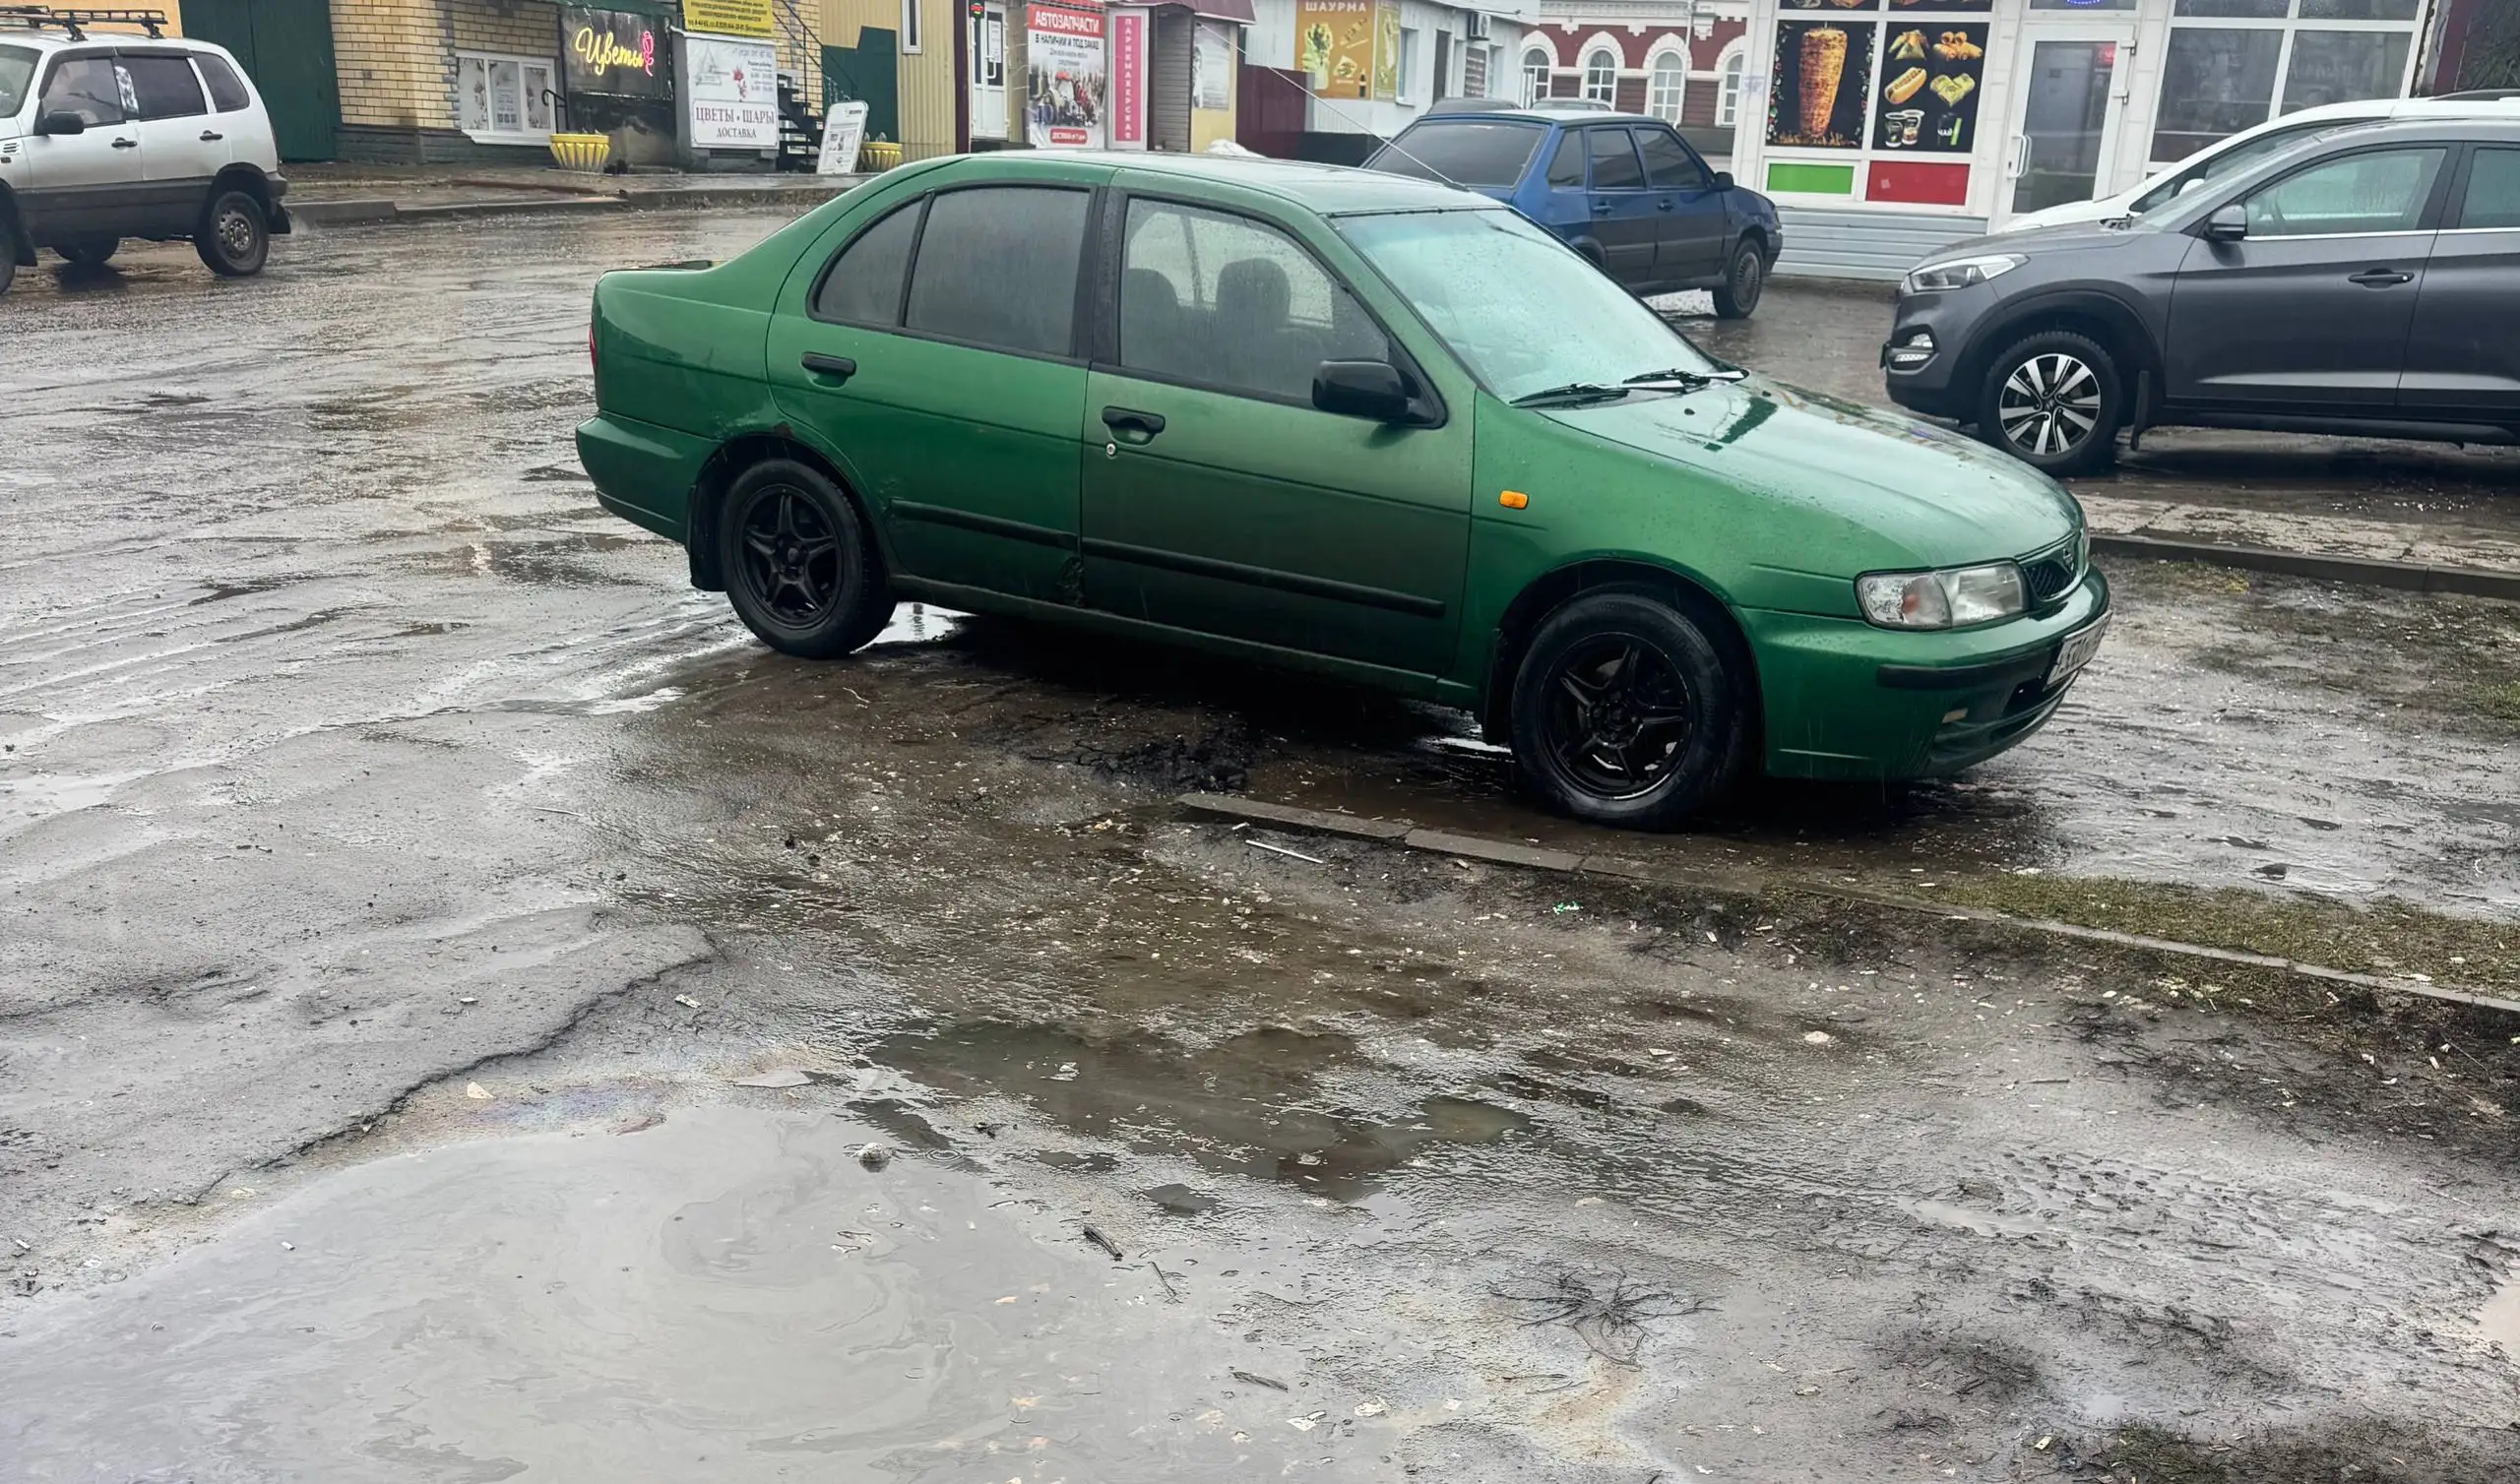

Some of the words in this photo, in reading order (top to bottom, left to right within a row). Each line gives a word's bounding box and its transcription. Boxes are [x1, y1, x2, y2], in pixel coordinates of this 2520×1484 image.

[1305, 2, 1366, 12] ШАУРМА
[1036, 11, 1100, 33] АВТОЗАПЧАСТИ
[576, 27, 644, 76] Цветы
[695, 107, 734, 124] ЦВЕТЫ
[742, 109, 775, 124] ШАРЫ
[717, 127, 757, 139] ДОСТАВКА
